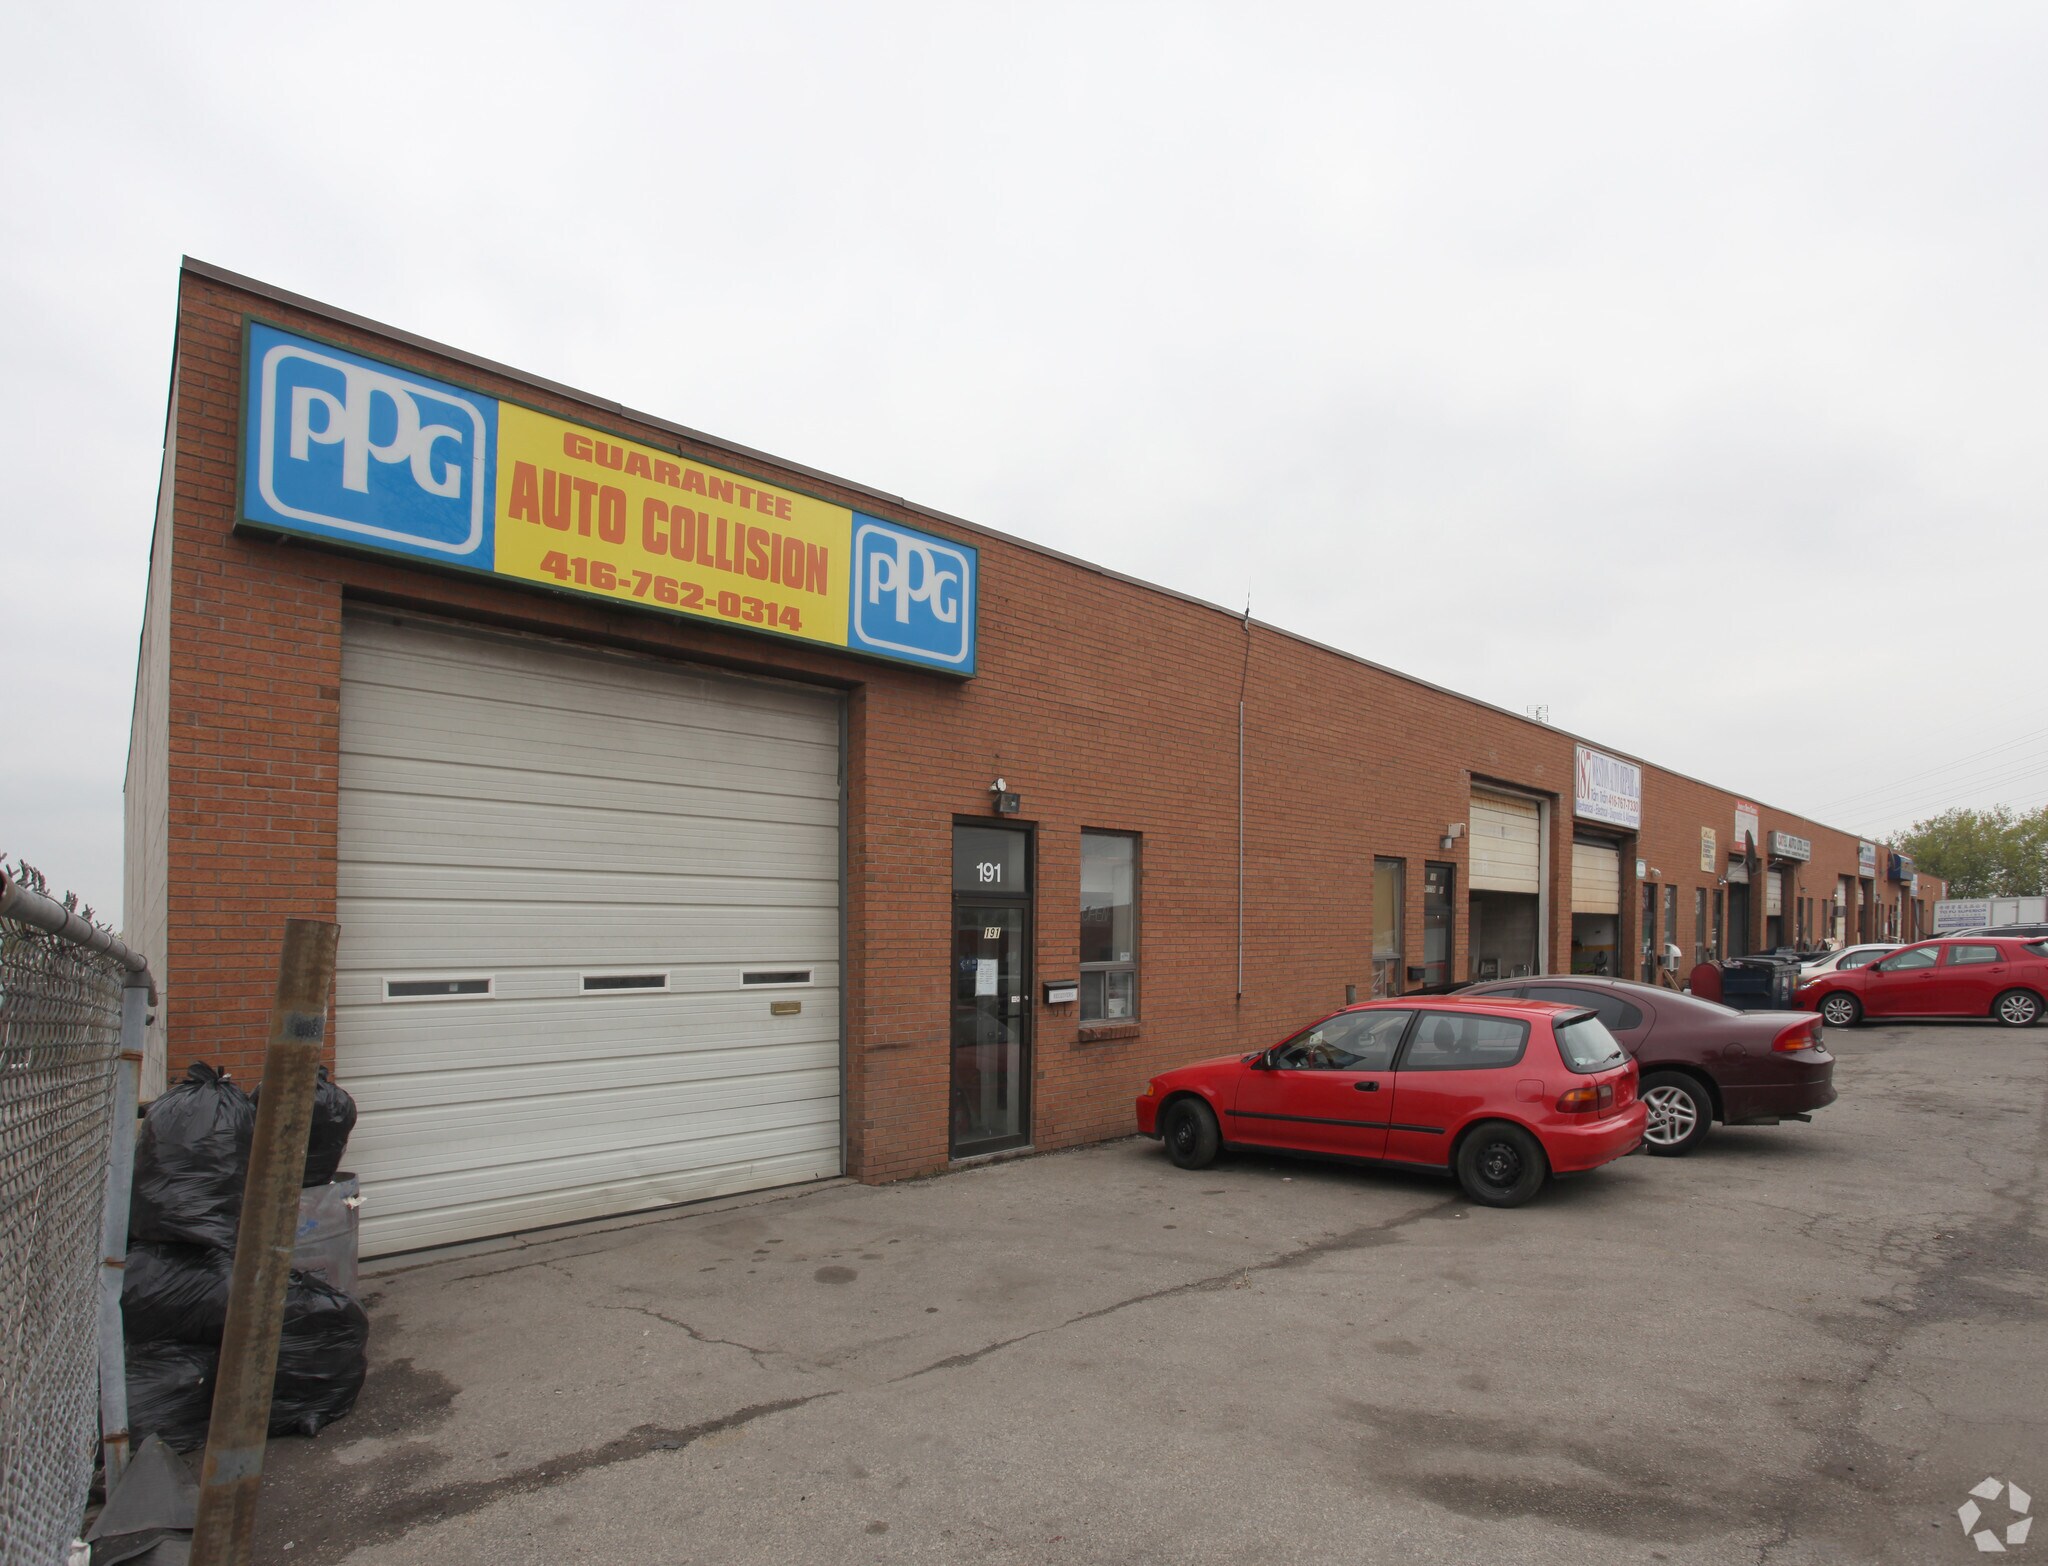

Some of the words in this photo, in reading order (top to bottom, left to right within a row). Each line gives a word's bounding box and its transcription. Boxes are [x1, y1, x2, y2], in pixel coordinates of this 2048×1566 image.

[289, 364, 463, 499] PPG
[563, 431, 792, 521] GUARANTEE
[508, 460, 627, 545] AUTO
[642, 497, 829, 596] COLLISION
[540, 550, 803, 631] 416-762-0314
[869, 532, 958, 624] PPG
[976, 862, 1001, 883] 191
[985, 927, 1000, 938] 191
